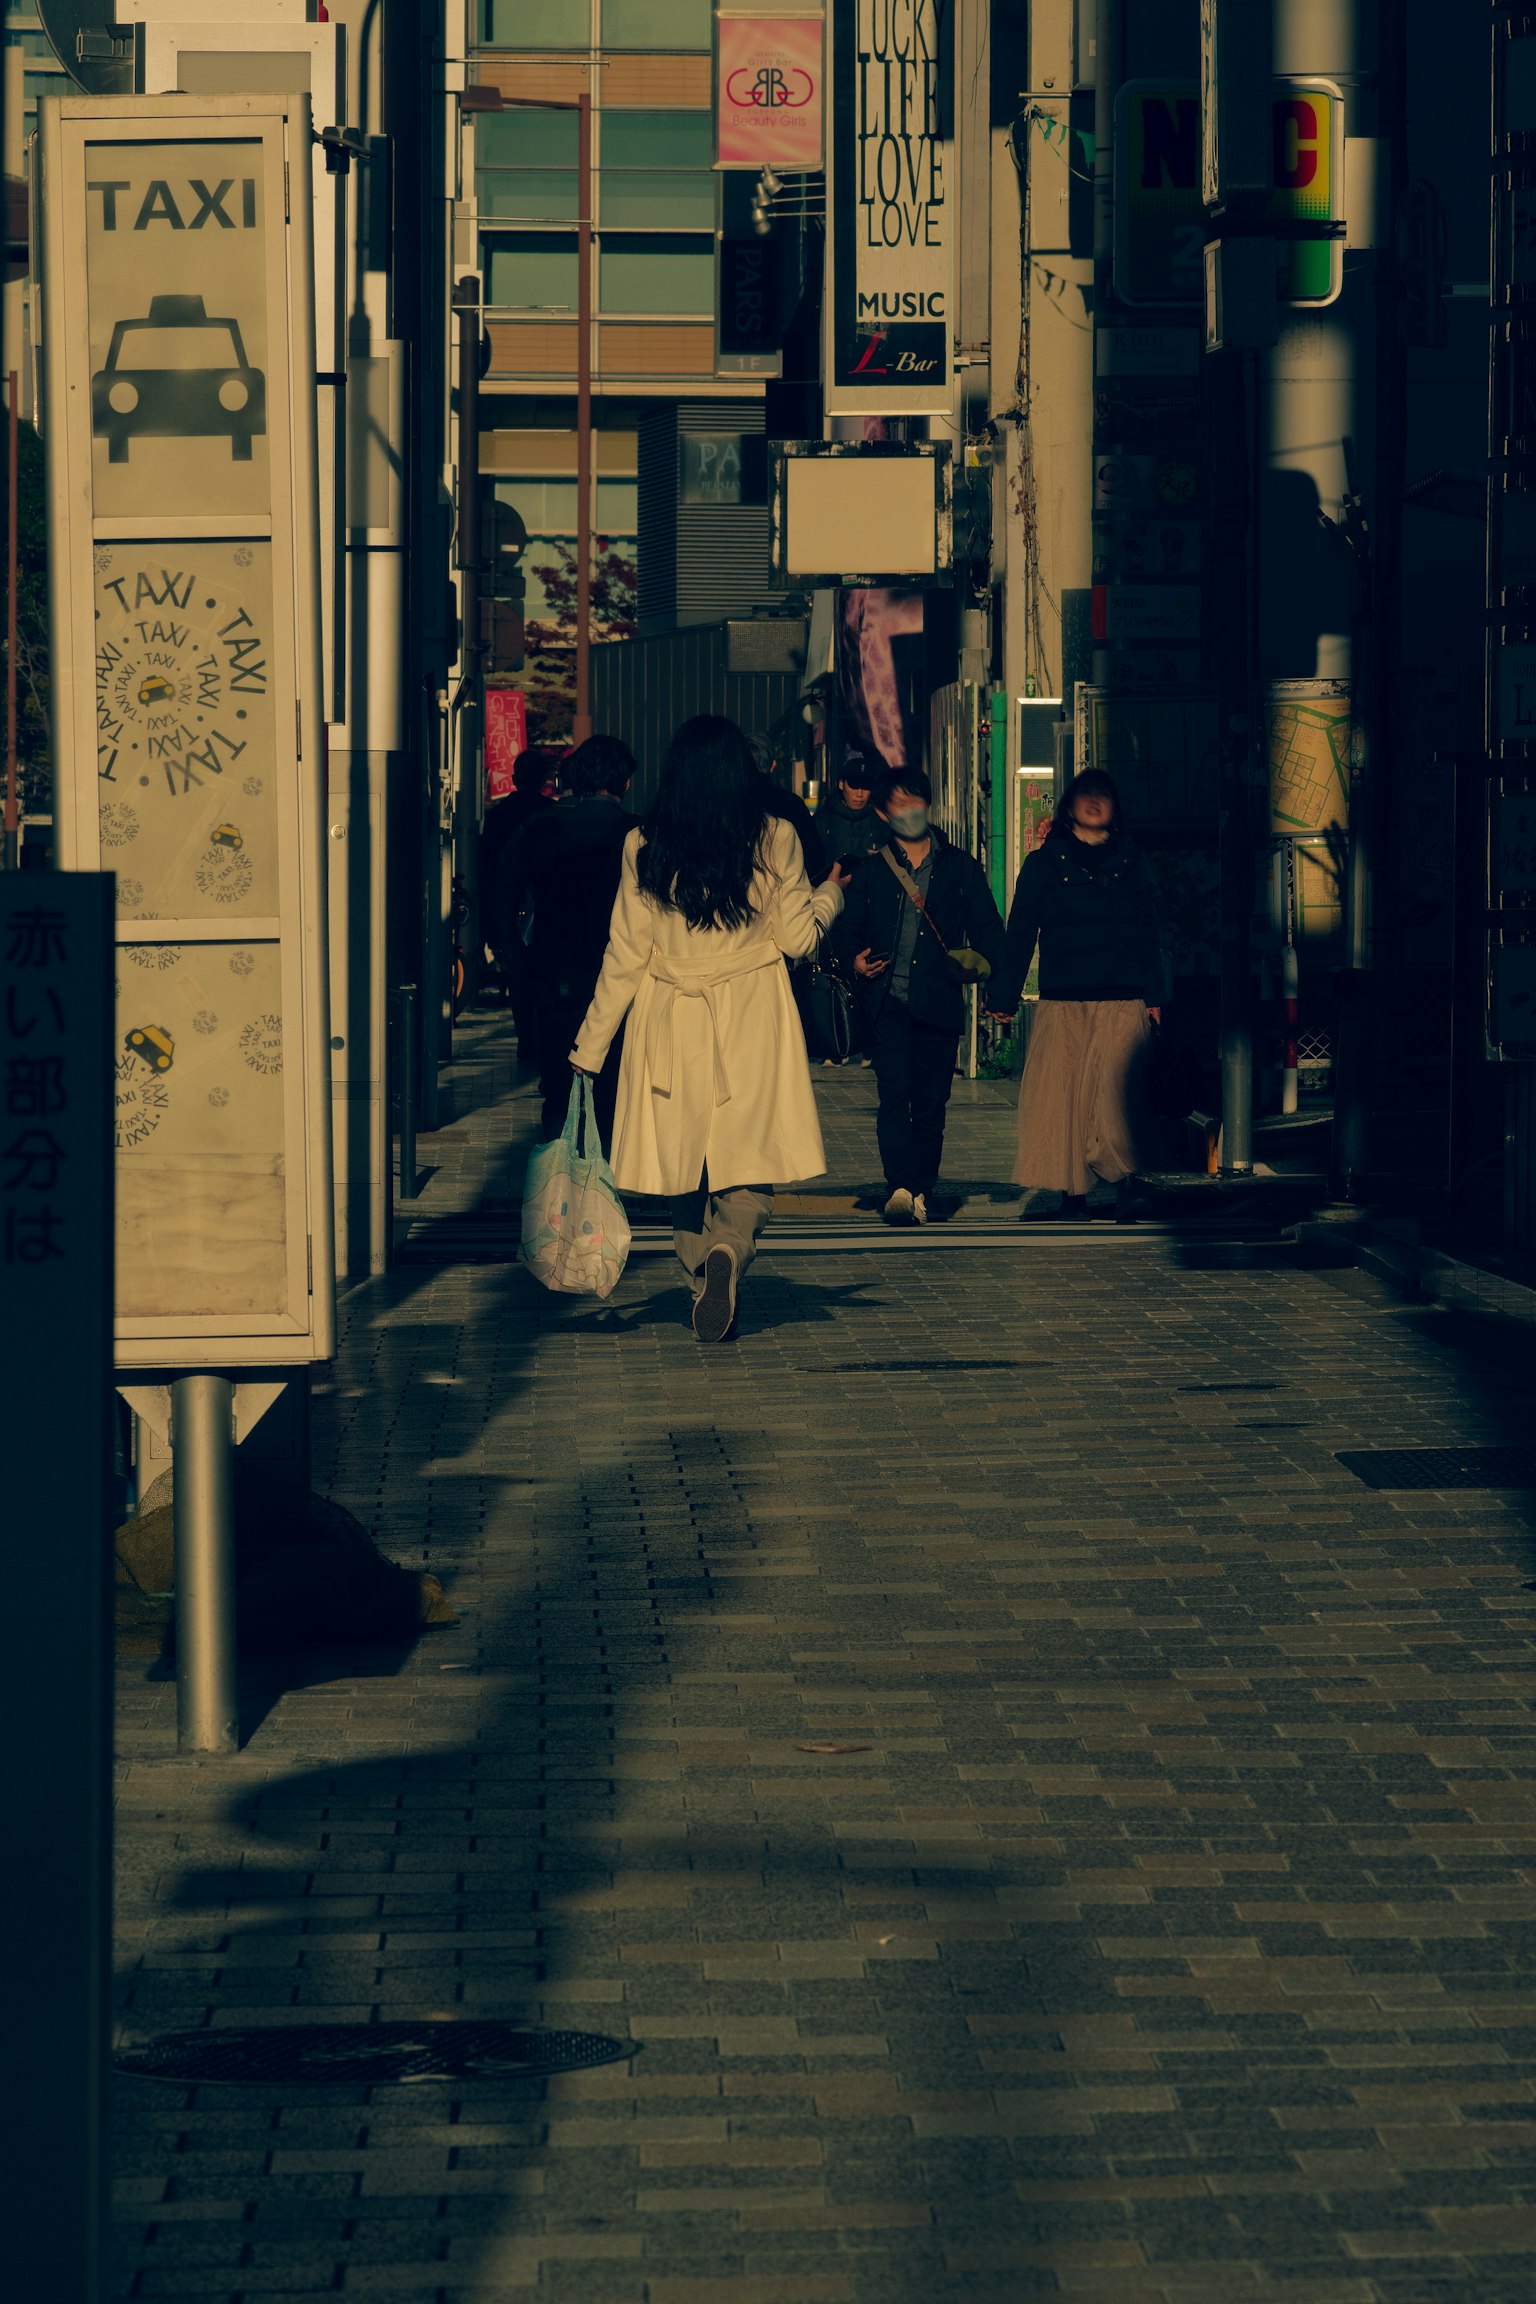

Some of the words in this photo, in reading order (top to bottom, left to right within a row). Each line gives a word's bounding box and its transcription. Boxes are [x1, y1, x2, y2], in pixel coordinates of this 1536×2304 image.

[859, 60, 945, 140] LIFE
[732, 114, 777, 128] Beauty
[780, 115, 808, 127] Girls
[859, 134, 945, 206] LOVE
[87, 178, 256, 231] TAXI
[868, 201, 942, 247] LOVE
[735, 248, 762, 333] PARS
[858, 292, 945, 317] MUSIC
[737, 357, 762, 371] 1F
[847, 331, 938, 375] L-Bar
[103, 569, 196, 614] TAXI
[134, 620, 190, 648] TAXI
[217, 606, 267, 695] TAXI
[144, 652, 176, 669] TAXI
[114, 663, 137, 693] TAXI
[178, 674, 193, 706] TAXI
[196, 654, 222, 710] TAXI
[114, 694, 138, 721] TAXI
[147, 713, 179, 731] TAXI
[148, 724, 201, 760] TAXI
[164, 729, 248, 797] TAXI
[262, 1039, 281, 1049] TAXI
[3, 904, 69, 1265] 赤い部分は
[116, 1090, 137, 1107] AXI
[126, 1119, 159, 1147] TAXI
